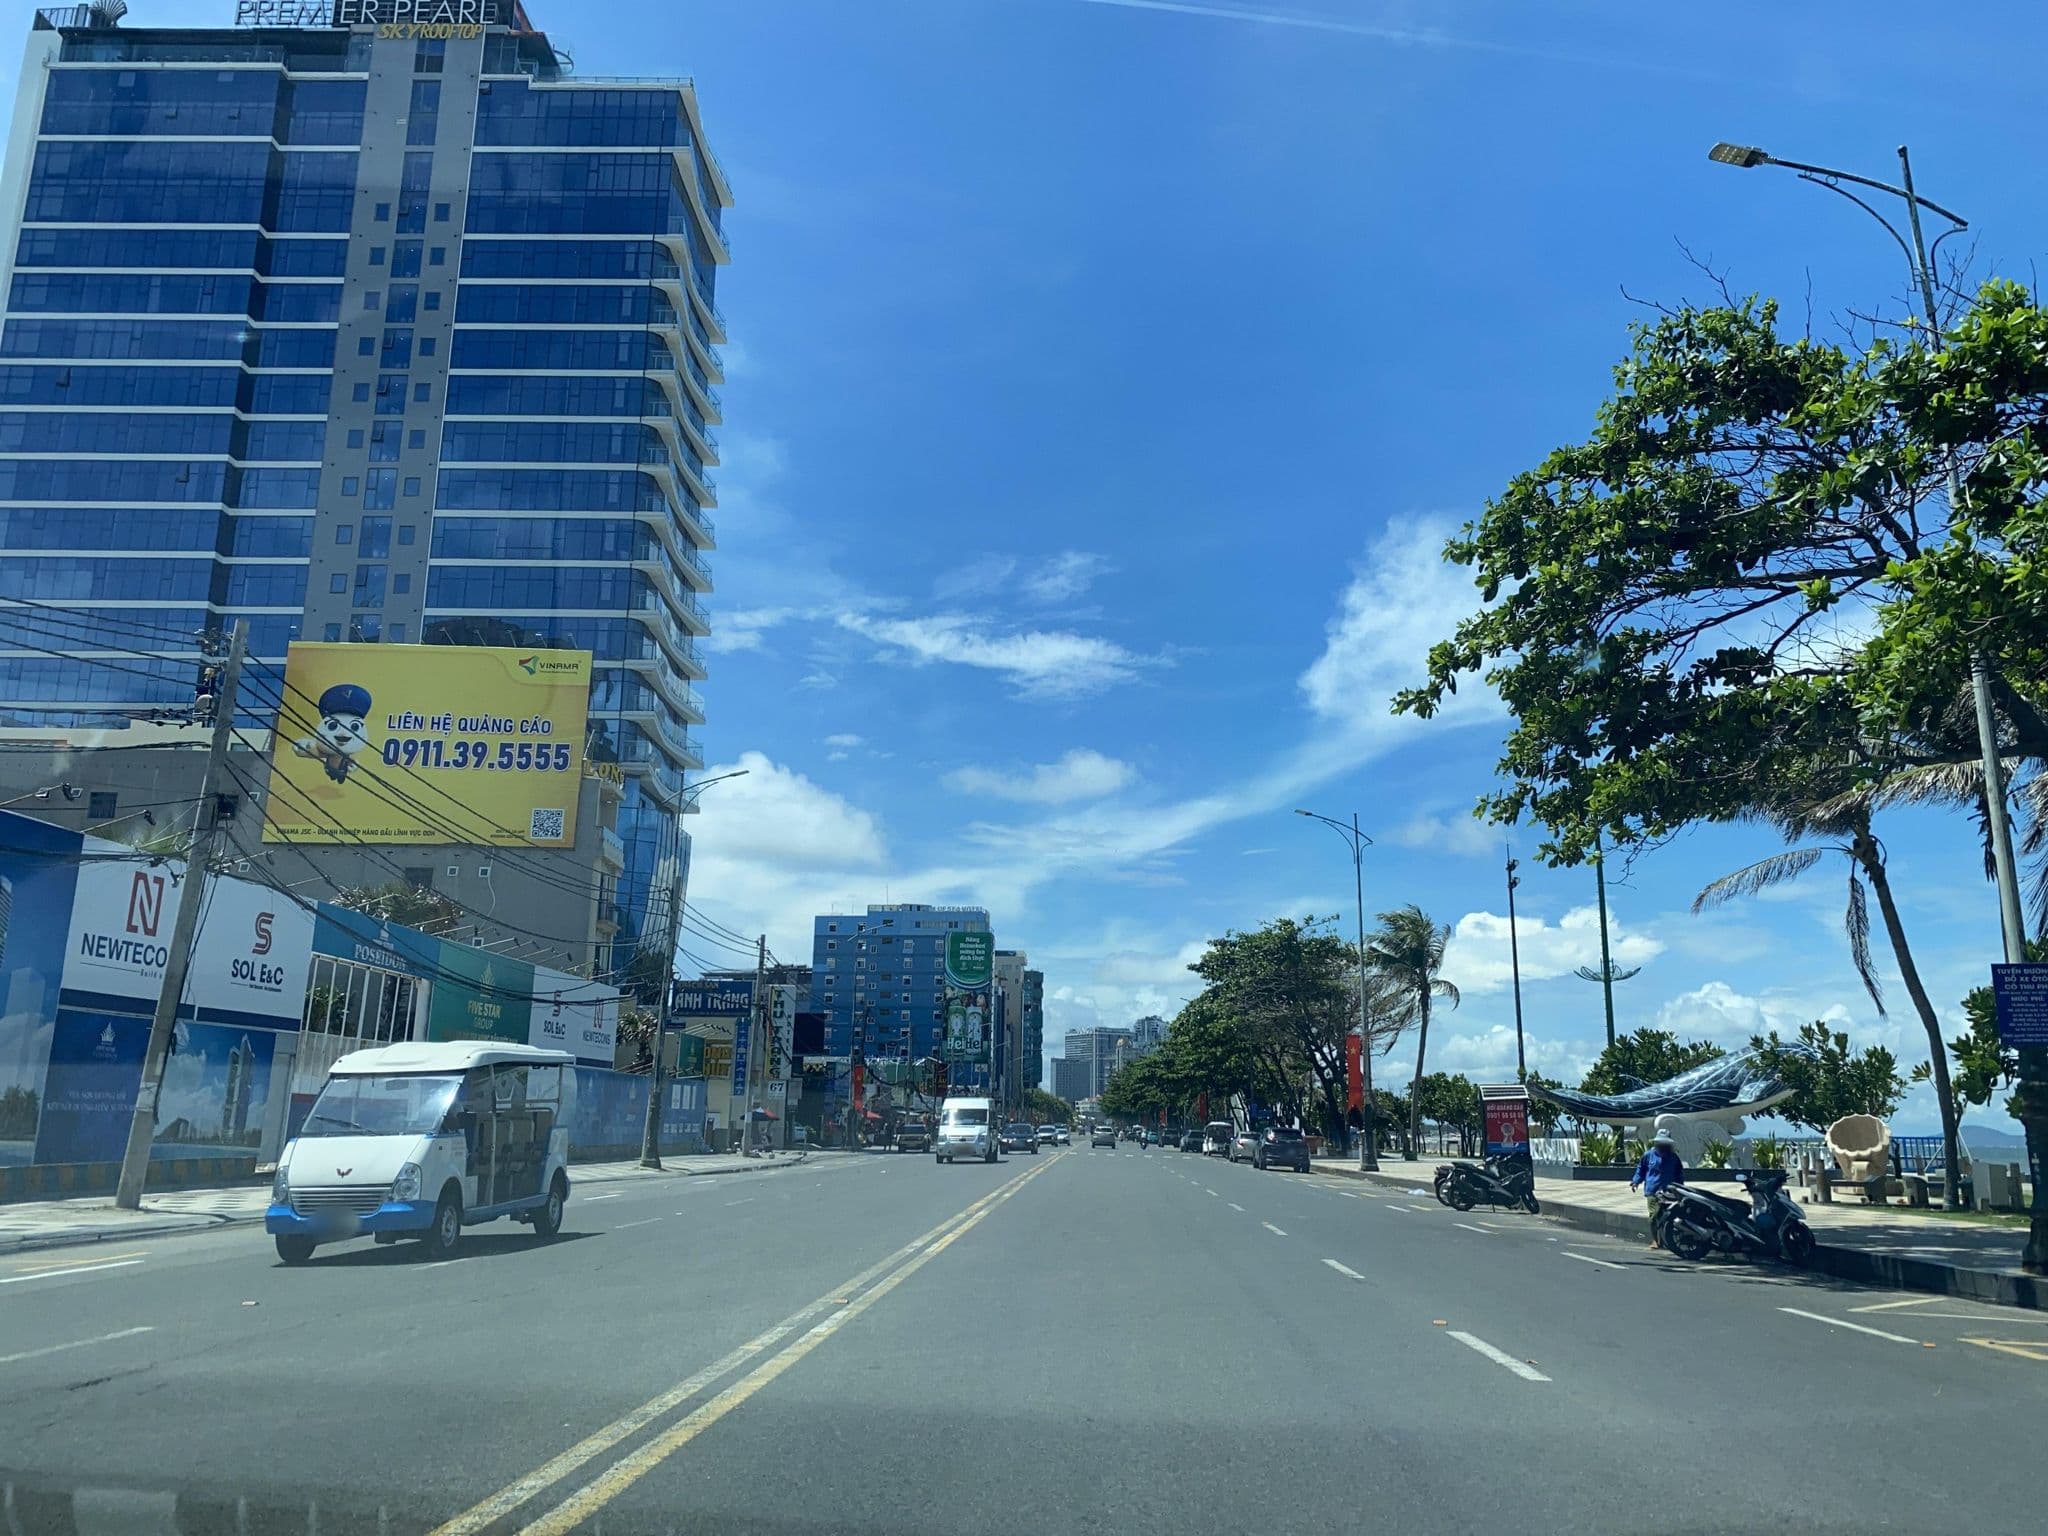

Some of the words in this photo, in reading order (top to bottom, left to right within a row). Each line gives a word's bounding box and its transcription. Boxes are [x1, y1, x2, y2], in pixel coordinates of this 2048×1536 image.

[235, 0, 377, 25] PREMIER
[393, 0, 493, 24] PEARL
[387, 711, 424, 730] LIÊN
[430, 713, 452, 736] HỆ
[458, 714, 514, 733] QUẢNG
[519, 716, 552, 734] CÁO
[382, 738, 571, 771] 0911.39.5555
[231, 958, 256, 982] SOL
[259, 963, 284, 986] E&C
[769, 1082, 785, 1092] 67
